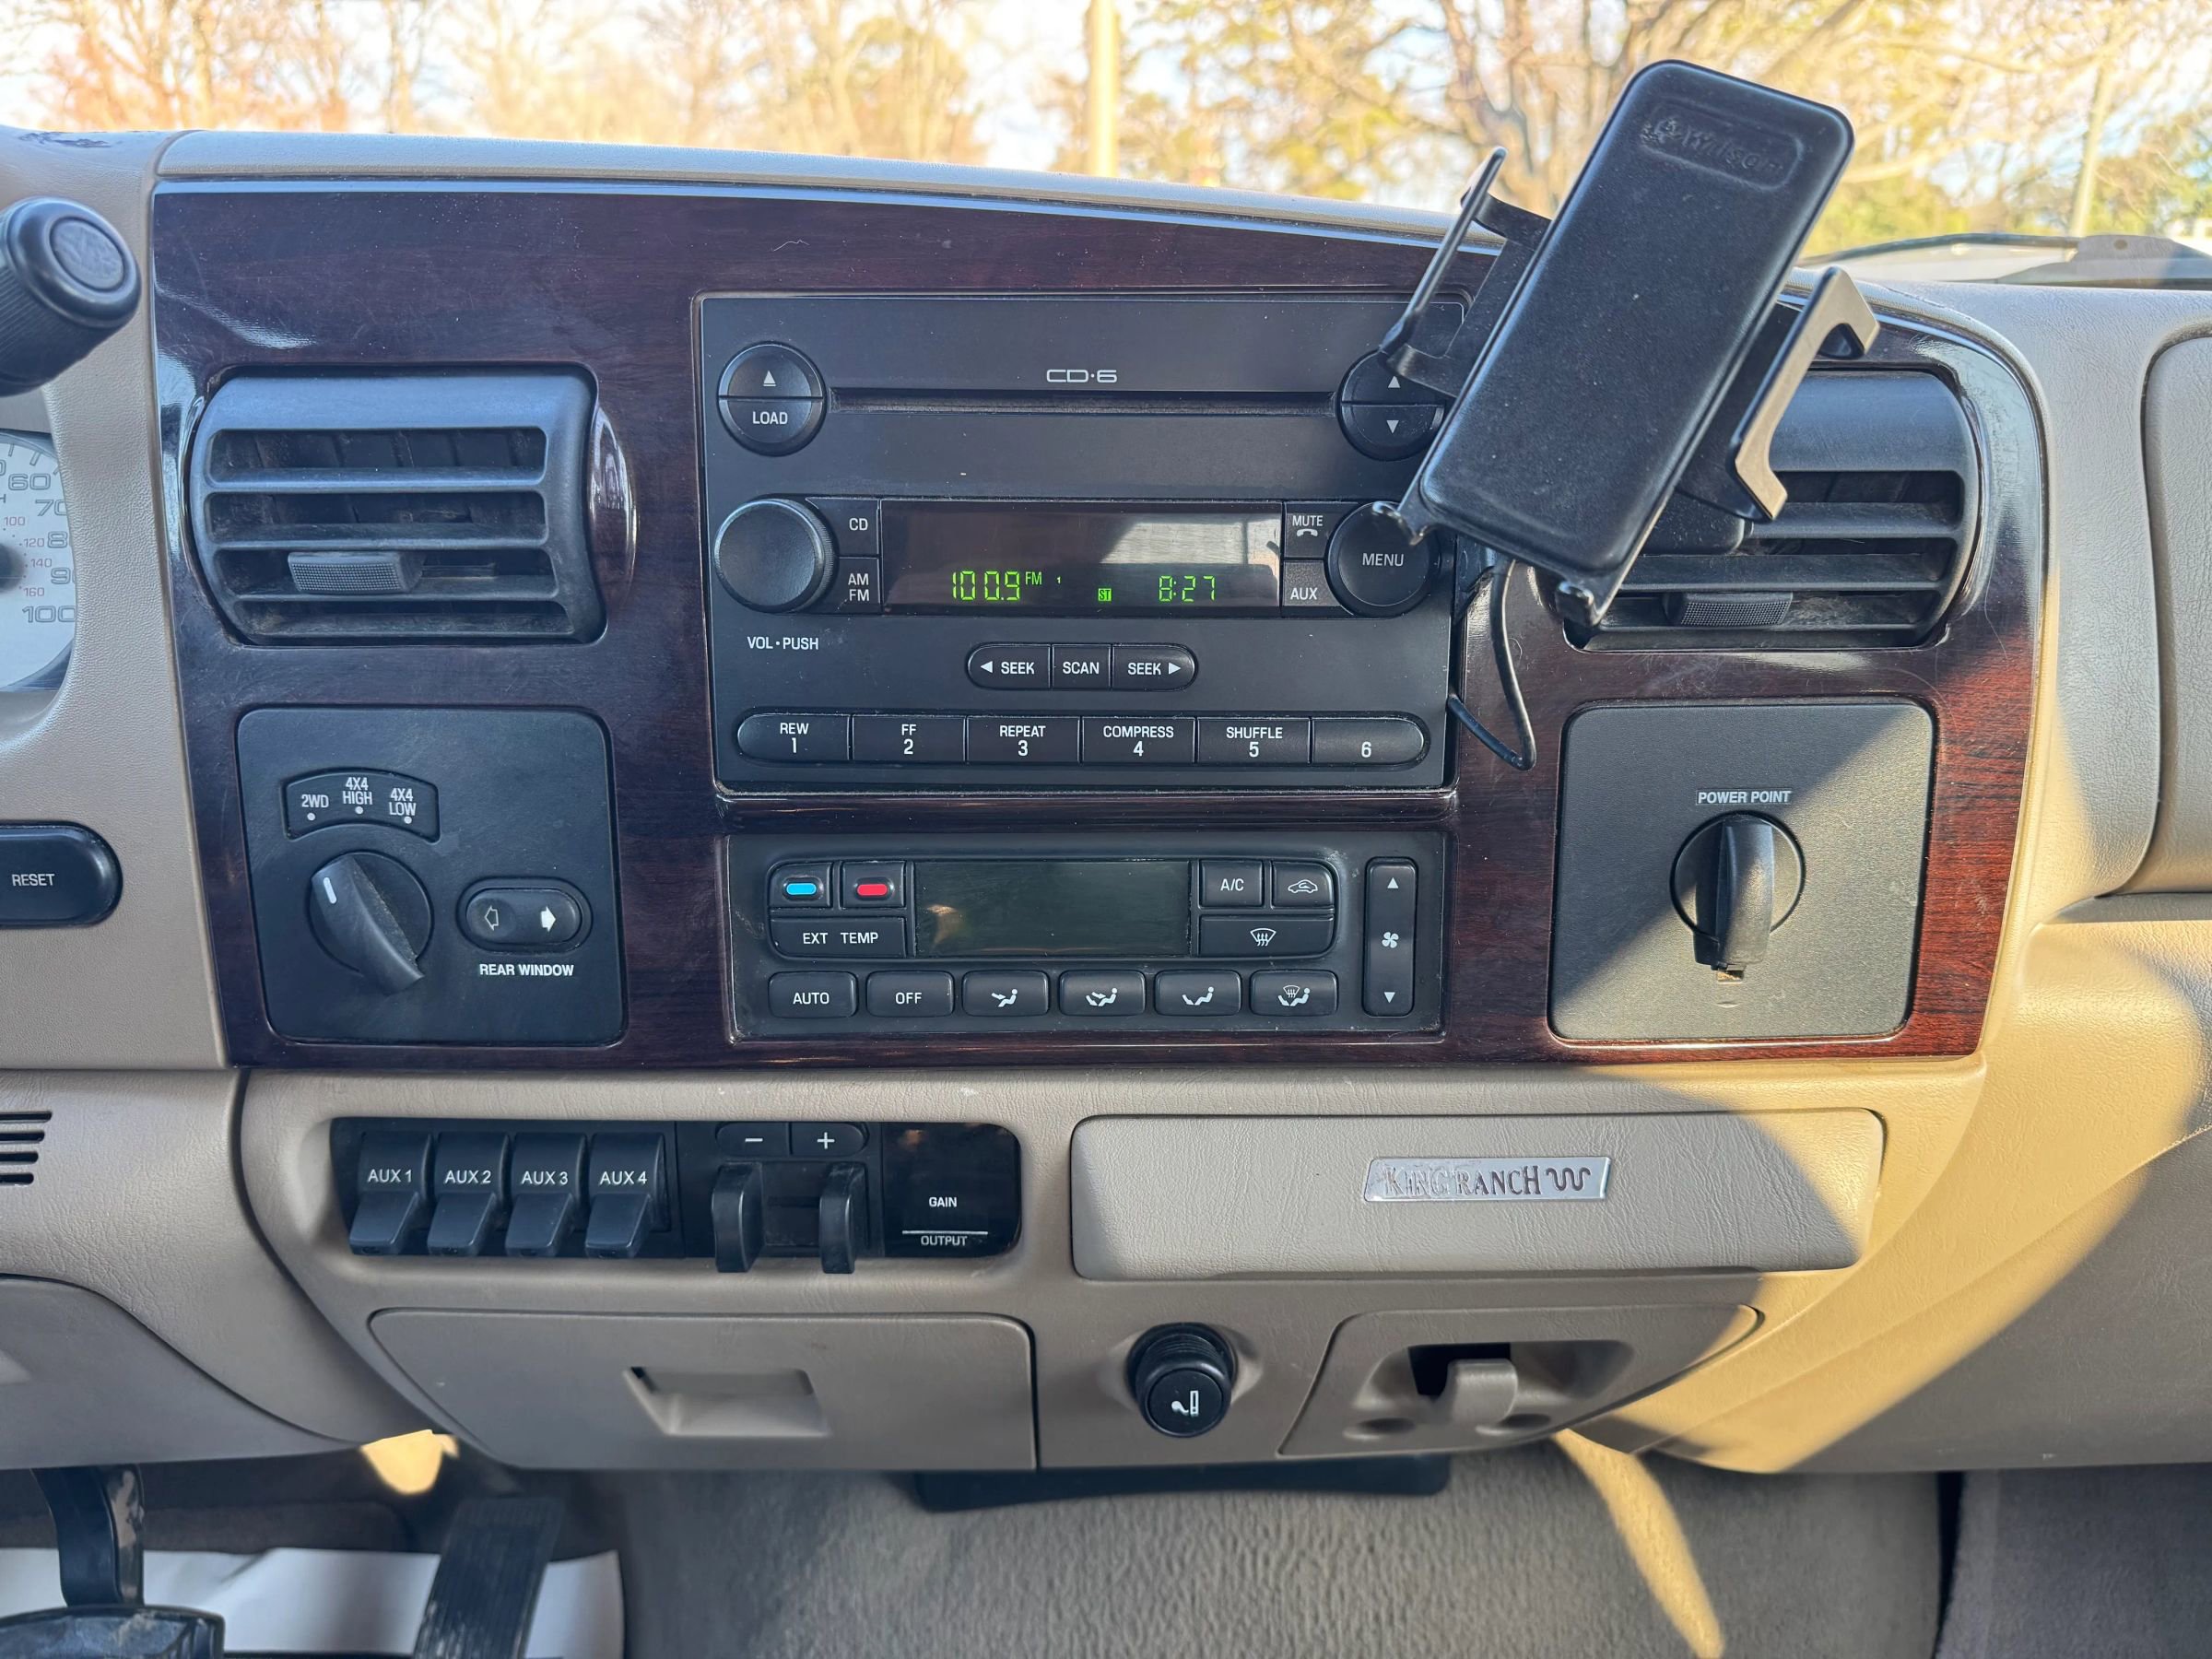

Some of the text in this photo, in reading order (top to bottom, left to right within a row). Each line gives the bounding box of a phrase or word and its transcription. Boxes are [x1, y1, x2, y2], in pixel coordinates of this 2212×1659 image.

[752, 410, 788, 426] LOAD
[7, 473, 51, 491] 60
[4, 516, 26, 526] 100
[849, 518, 868, 532] CD
[1292, 515, 1324, 527] MUTE
[23, 537, 45, 547] 120
[47, 531, 68, 549] 8
[30, 559, 53, 568] 140
[1362, 553, 1404, 567] MENU
[51, 567, 76, 585] 9
[847, 573, 869, 586] AM
[23, 587, 45, 597] 160
[951, 571, 1020, 601] 100.9
[1025, 571, 1042, 585] FM
[1159, 575, 1217, 602] 8:27
[849, 589, 870, 602] FM
[1290, 587, 1318, 600] AUX
[22, 606, 76, 623] 100
[1000, 662, 1035, 675] SEEK
[1062, 662, 1100, 675] SCAN
[1127, 663, 1161, 676] SEEK
[780, 723, 809, 735] REW
[901, 724, 916, 735] FF
[999, 725, 1046, 737] REPEAT
[1103, 725, 1174, 738] COMPRESS
[1226, 727, 1283, 739] SHUFFLE
[791, 738, 797, 753] 1
[903, 739, 913, 755] 2
[1018, 741, 1029, 756] 3
[1133, 742, 1144, 757] 4
[1248, 743, 1259, 758] 5
[1361, 742, 1371, 758] 6
[346, 778, 369, 791] 4X4
[301, 794, 329, 808] 2WD
[342, 792, 372, 806] HIGH
[390, 788, 413, 802] 4X4
[1698, 791, 1791, 804] POWER POINT
[389, 803, 417, 817] LOW
[12, 874, 54, 887] RESET
[1220, 878, 1244, 891] A/C
[803, 932, 878, 945] EXT TEMP
[479, 963, 574, 977] REAR WINDOW
[793, 992, 830, 1005] AUTO
[896, 992, 922, 1005] OFF
[368, 1169, 412, 1182] AUX 1
[444, 1170, 491, 1183] AUX 2
[522, 1171, 569, 1184] AUX 3
[599, 1171, 647, 1184] AUX 4
[1384, 1166, 1541, 1196] KING RANCH
[928, 1196, 958, 1207] GAIN
[921, 1235, 967, 1246] OUTPUT
